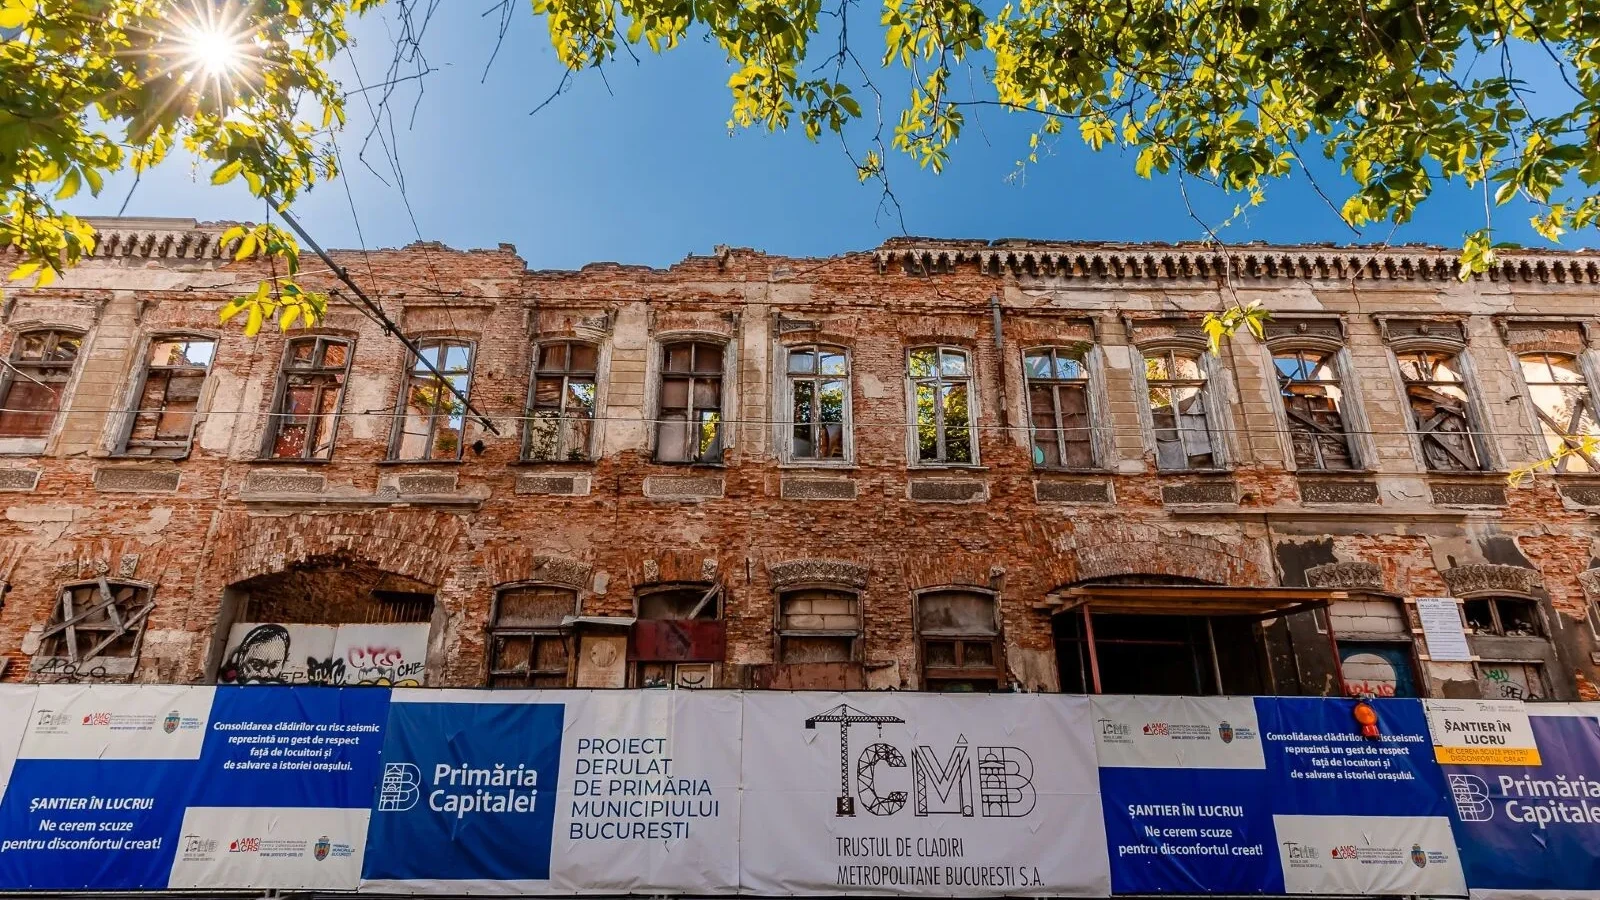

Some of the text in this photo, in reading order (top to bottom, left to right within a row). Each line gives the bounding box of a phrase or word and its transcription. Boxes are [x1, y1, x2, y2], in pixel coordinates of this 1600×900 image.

[213, 722, 272, 732] Consolidarea
[275, 721, 314, 732] clădirilor
[316, 724, 327, 732] cu
[328, 722, 344, 732] risc
[346, 722, 379, 732] seismic
[1445, 719, 1511, 733] ȘANTIER ÎN
[228, 734, 359, 746] reprezintă un gest de respect
[1267, 732, 1322, 742] Consolidarea
[1392, 733, 1424, 743] seismic
[1464, 735, 1505, 745] LUCRU
[250, 747, 331, 758] față de locuitori și
[578, 738, 666, 754] PROIECT
[1285, 745, 1330, 756] reprezintă
[1346, 746, 1364, 757] gest
[1366, 746, 1377, 755] de
[1379, 747, 1409, 757] respect
[224, 760, 235, 769] de
[237, 760, 271, 769] salvare
[280, 761, 311, 770] istoriei
[313, 761, 352, 772] orașului.
[576, 758, 672, 775] DERULAT
[1312, 757, 1390, 769] față de locuitori și
[434, 763, 538, 787] Primăria
[1291, 770, 1302, 779] de
[1305, 770, 1334, 779] salvare
[1344, 770, 1375, 779] istoriei
[1377, 771, 1415, 782] orașului.
[574, 775, 712, 796] DE PRIMĂRIA
[1498, 775, 1600, 798] Primăria
[30, 796, 153, 812] ȘANTIER ÎN LUCRU!
[429, 789, 536, 818] Capitalei
[571, 800, 719, 818] MUNICIPIULUI
[1128, 803, 1243, 818] ȘANTIER ÎN LUCRU!
[39, 819, 133, 832] Ne cerem scuze
[569, 822, 689, 843] BUCUREȘTI
[1145, 826, 1232, 838] Ne cerem scuze
[2, 838, 161, 852] pentru disconfortul creat!
[836, 837, 963, 857] TRUSTUL DE CLADIRI
[1118, 844, 1263, 858] pentru disconfortul creat!
[836, 866, 1045, 886] METROPOLITANE BUCURESTI S.A.
